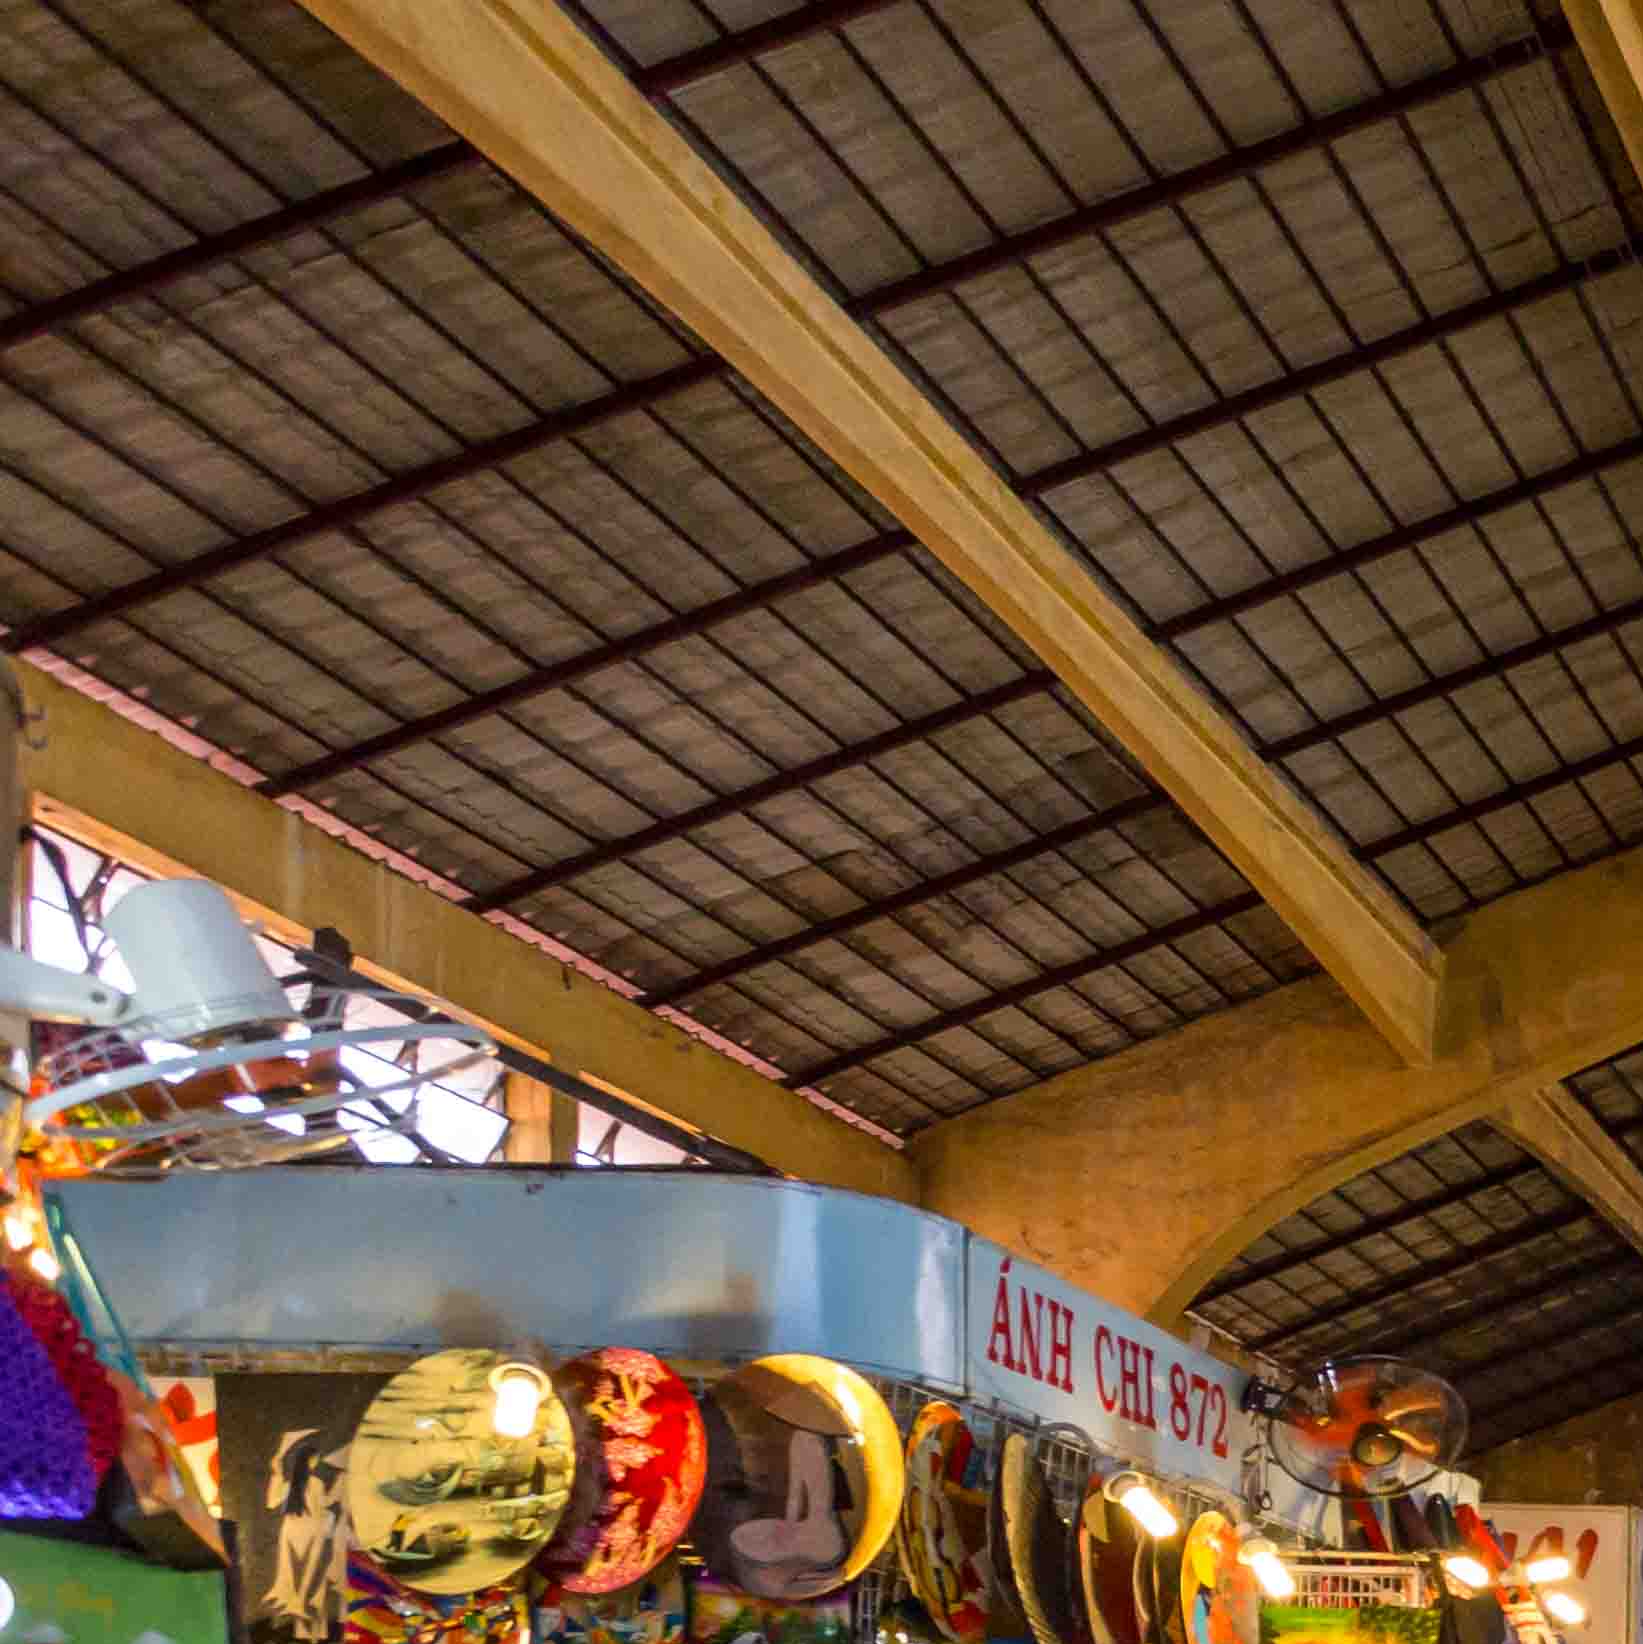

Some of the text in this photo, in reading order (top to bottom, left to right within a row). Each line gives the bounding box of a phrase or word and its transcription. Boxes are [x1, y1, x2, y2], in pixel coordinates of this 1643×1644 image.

[986, 1256, 1228, 1459] ÁNH CHI 872
